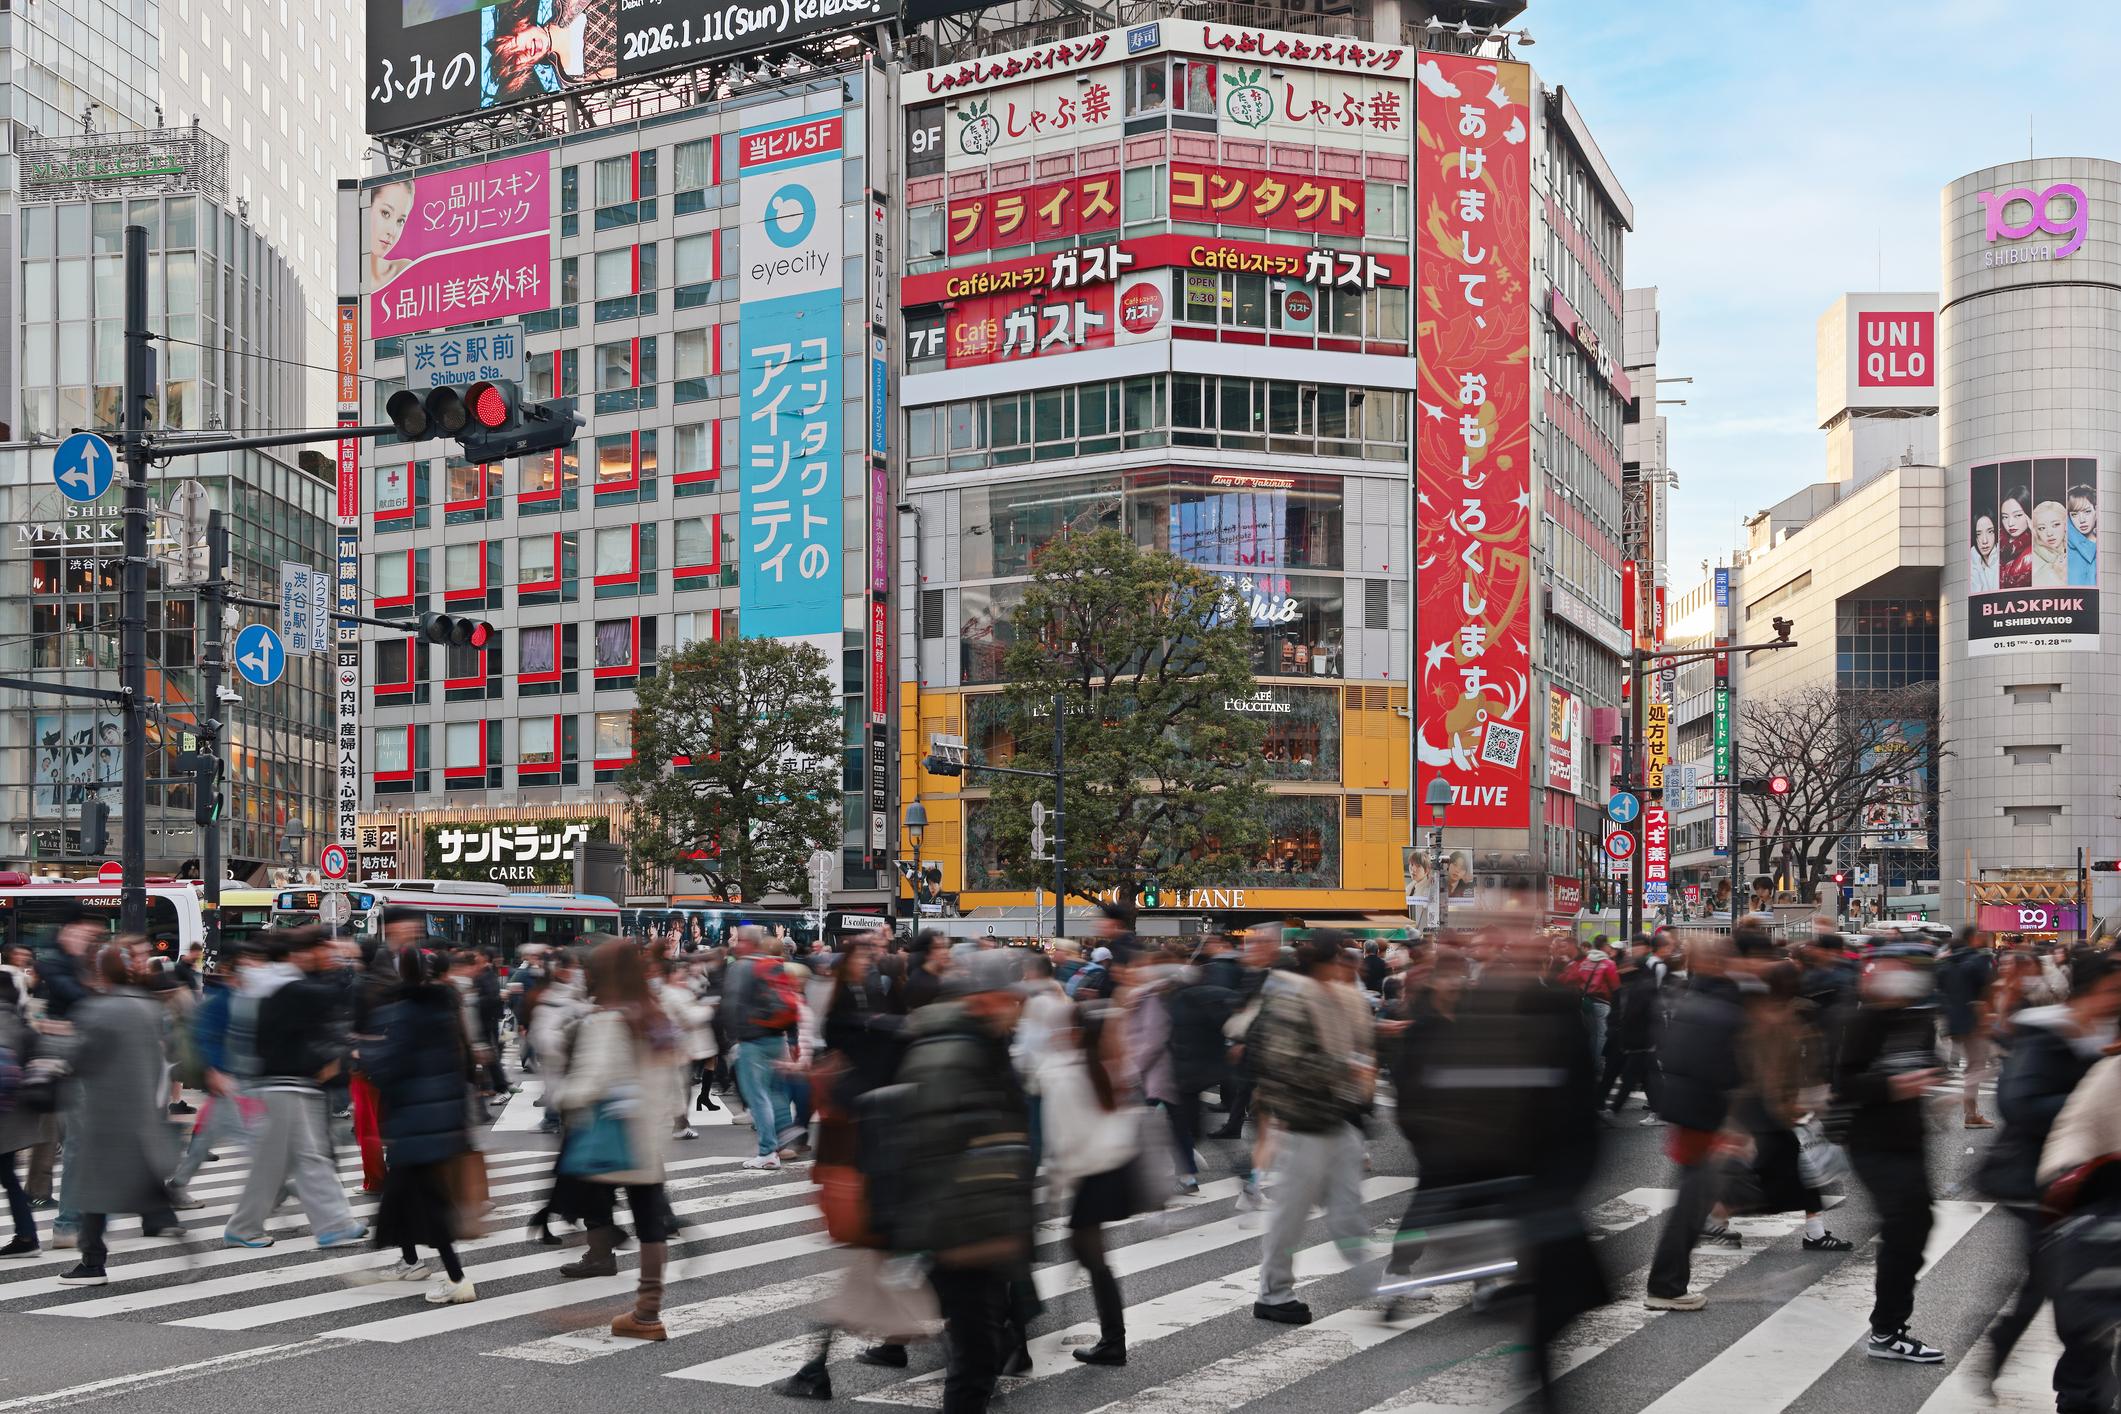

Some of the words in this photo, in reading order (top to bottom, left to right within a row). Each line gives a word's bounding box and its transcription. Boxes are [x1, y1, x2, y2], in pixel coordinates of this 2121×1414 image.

[1130, 28, 1158, 49] 寿司
[1203, 26, 1404, 71] しゃぶしゃぶバイキング
[371, 51, 477, 104] ふみの
[927, 35, 1110, 93] しゃぶしゃぶバイキング
[1007, 84, 1112, 138] しゃぶ葉
[1285, 83, 1402, 130] しゃぶ葉
[749, 123, 832, 162] 当ビル5F
[912, 126, 941, 153] 9F
[31, 161, 107, 177] MARK
[115, 154, 179, 171] CITY
[448, 170, 541, 211] 品川スキン
[1171, 171, 1358, 223] コンタクト
[449, 200, 530, 237] クリニック
[951, 180, 1119, 244] プライス
[1458, 104, 1487, 329] あけまして、
[1977, 183, 2089, 259] 109
[751, 249, 830, 285] eyecity
[874, 232, 884, 310] 献血ルーム
[946, 264, 1046, 299] Caféレストラン
[1051, 244, 1134, 290] ガスト
[1190, 245, 1299, 274] Caféレストラン
[1305, 248, 1392, 290] ガスト
[1984, 246, 2050, 268] SHIBUYA
[396, 263, 541, 320] 品川美容外科
[1189, 276, 1215, 287] OPEN
[1125, 304, 1160, 321] ガスト
[1190, 292, 1215, 303] 7:30
[1288, 303, 1310, 313] ガスト
[876, 313, 884, 323] 6F
[955, 316, 998, 344] Café
[1001, 301, 1104, 358] ガスト
[909, 327, 945, 358] 7F
[955, 340, 998, 358] レストラン
[1867, 321, 1920, 347] UNI
[342, 323, 354, 400] 東京スター銀行
[414, 332, 515, 370] 渋谷駅前
[431, 370, 476, 388] Shibuya
[480, 367, 504, 380] Sta.
[1867, 352, 1926, 382] QLO
[342, 402, 353, 411] 8F
[751, 344, 792, 583] アイシティ
[799, 337, 830, 580] コンタクトの
[67, 506, 118, 518] SHIB
[342, 517, 355, 525] 7F
[17, 523, 118, 542] MARK
[875, 491, 884, 572] 品川美容外科
[1458, 372, 1488, 722] おもしろくします。
[874, 578, 884, 588] 4F
[1716, 572, 1727, 584] THE
[284, 581, 292, 617] Shibuya
[293, 571, 308, 650] 渋谷駅前
[1982, 598, 2084, 617] BLACKPINK
[340, 629, 356, 640] 5F
[2005, 616, 2073, 627] SHIBUYA109
[340, 655, 356, 666] 3F
[340, 690, 356, 717] 内科
[875, 713, 884, 723] 7F
[1224, 698, 1291, 713] L'OCCITANE
[1551, 696, 1561, 736] 薬
[1649, 706, 1666, 771] 処方せん
[1717, 692, 1727, 774] ビリヤード・ダーツ
[340, 722, 356, 841] 産婦人科・心療内科
[1652, 775, 1662, 787] 3
[1670, 769, 1680, 808] 渋谷駅前
[363, 829, 377, 848] 薬
[381, 831, 397, 845] 2F
[438, 824, 590, 863] サンドラッグ
[1648, 810, 1667, 879] スギ薬局
[362, 856, 397, 869] 処方せん
[489, 865, 536, 881] CARER
[323, 882, 348, 891] ここまで
[853, 917, 884, 928] collection
[2017, 909, 2048, 929] 109
